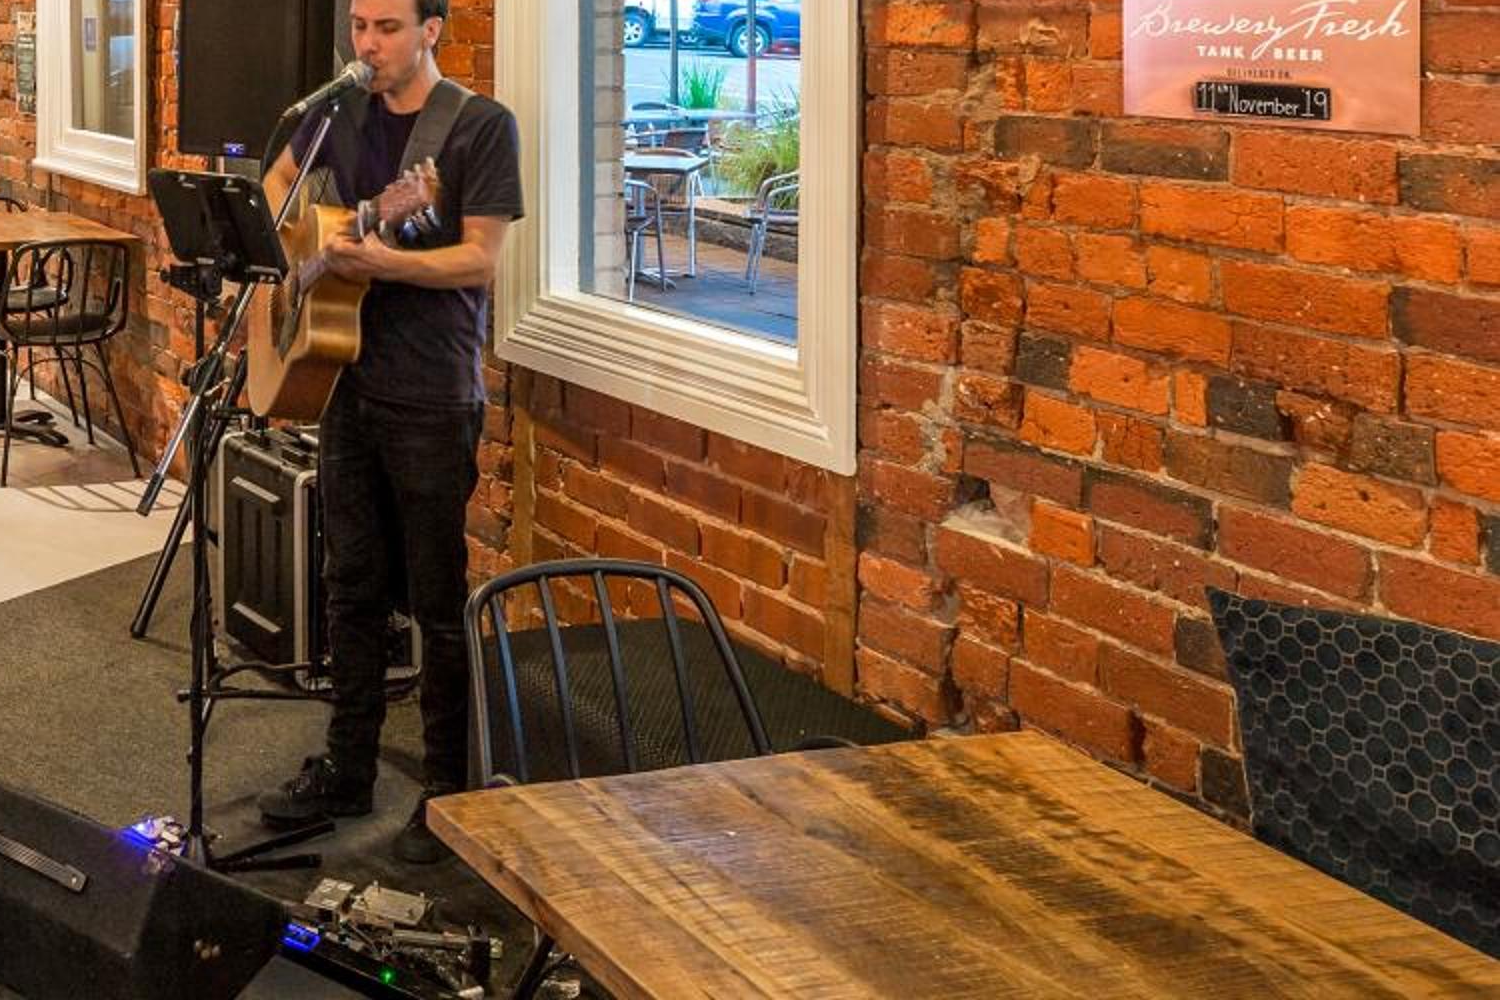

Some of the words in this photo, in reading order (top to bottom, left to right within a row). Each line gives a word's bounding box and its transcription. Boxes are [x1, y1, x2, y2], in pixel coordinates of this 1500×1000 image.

[1131, 0, 1287, 62] Brewery
[1196, 44, 1245, 59] TANK
[1273, 47, 1324, 62] BEER
[1229, 84, 1300, 115] November
